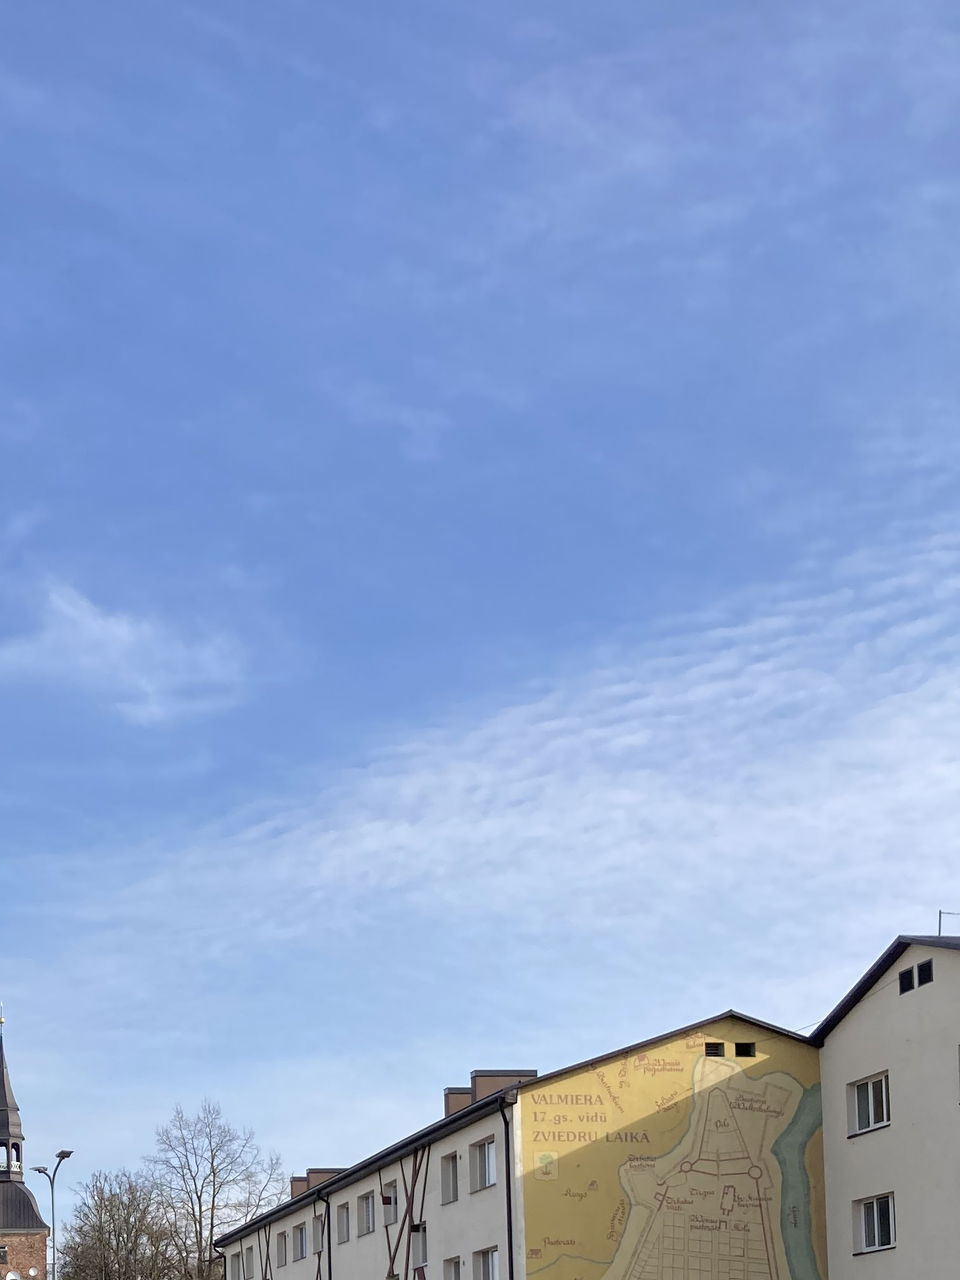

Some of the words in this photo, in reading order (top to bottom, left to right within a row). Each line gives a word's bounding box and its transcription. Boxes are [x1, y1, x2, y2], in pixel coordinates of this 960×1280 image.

[531, 1094, 604, 1106] VALMIERA
[578, 1112, 607, 1123] vidū
[533, 1131, 598, 1142] ZVIEDRU
[605, 1130, 650, 1143] LAIKĀ
